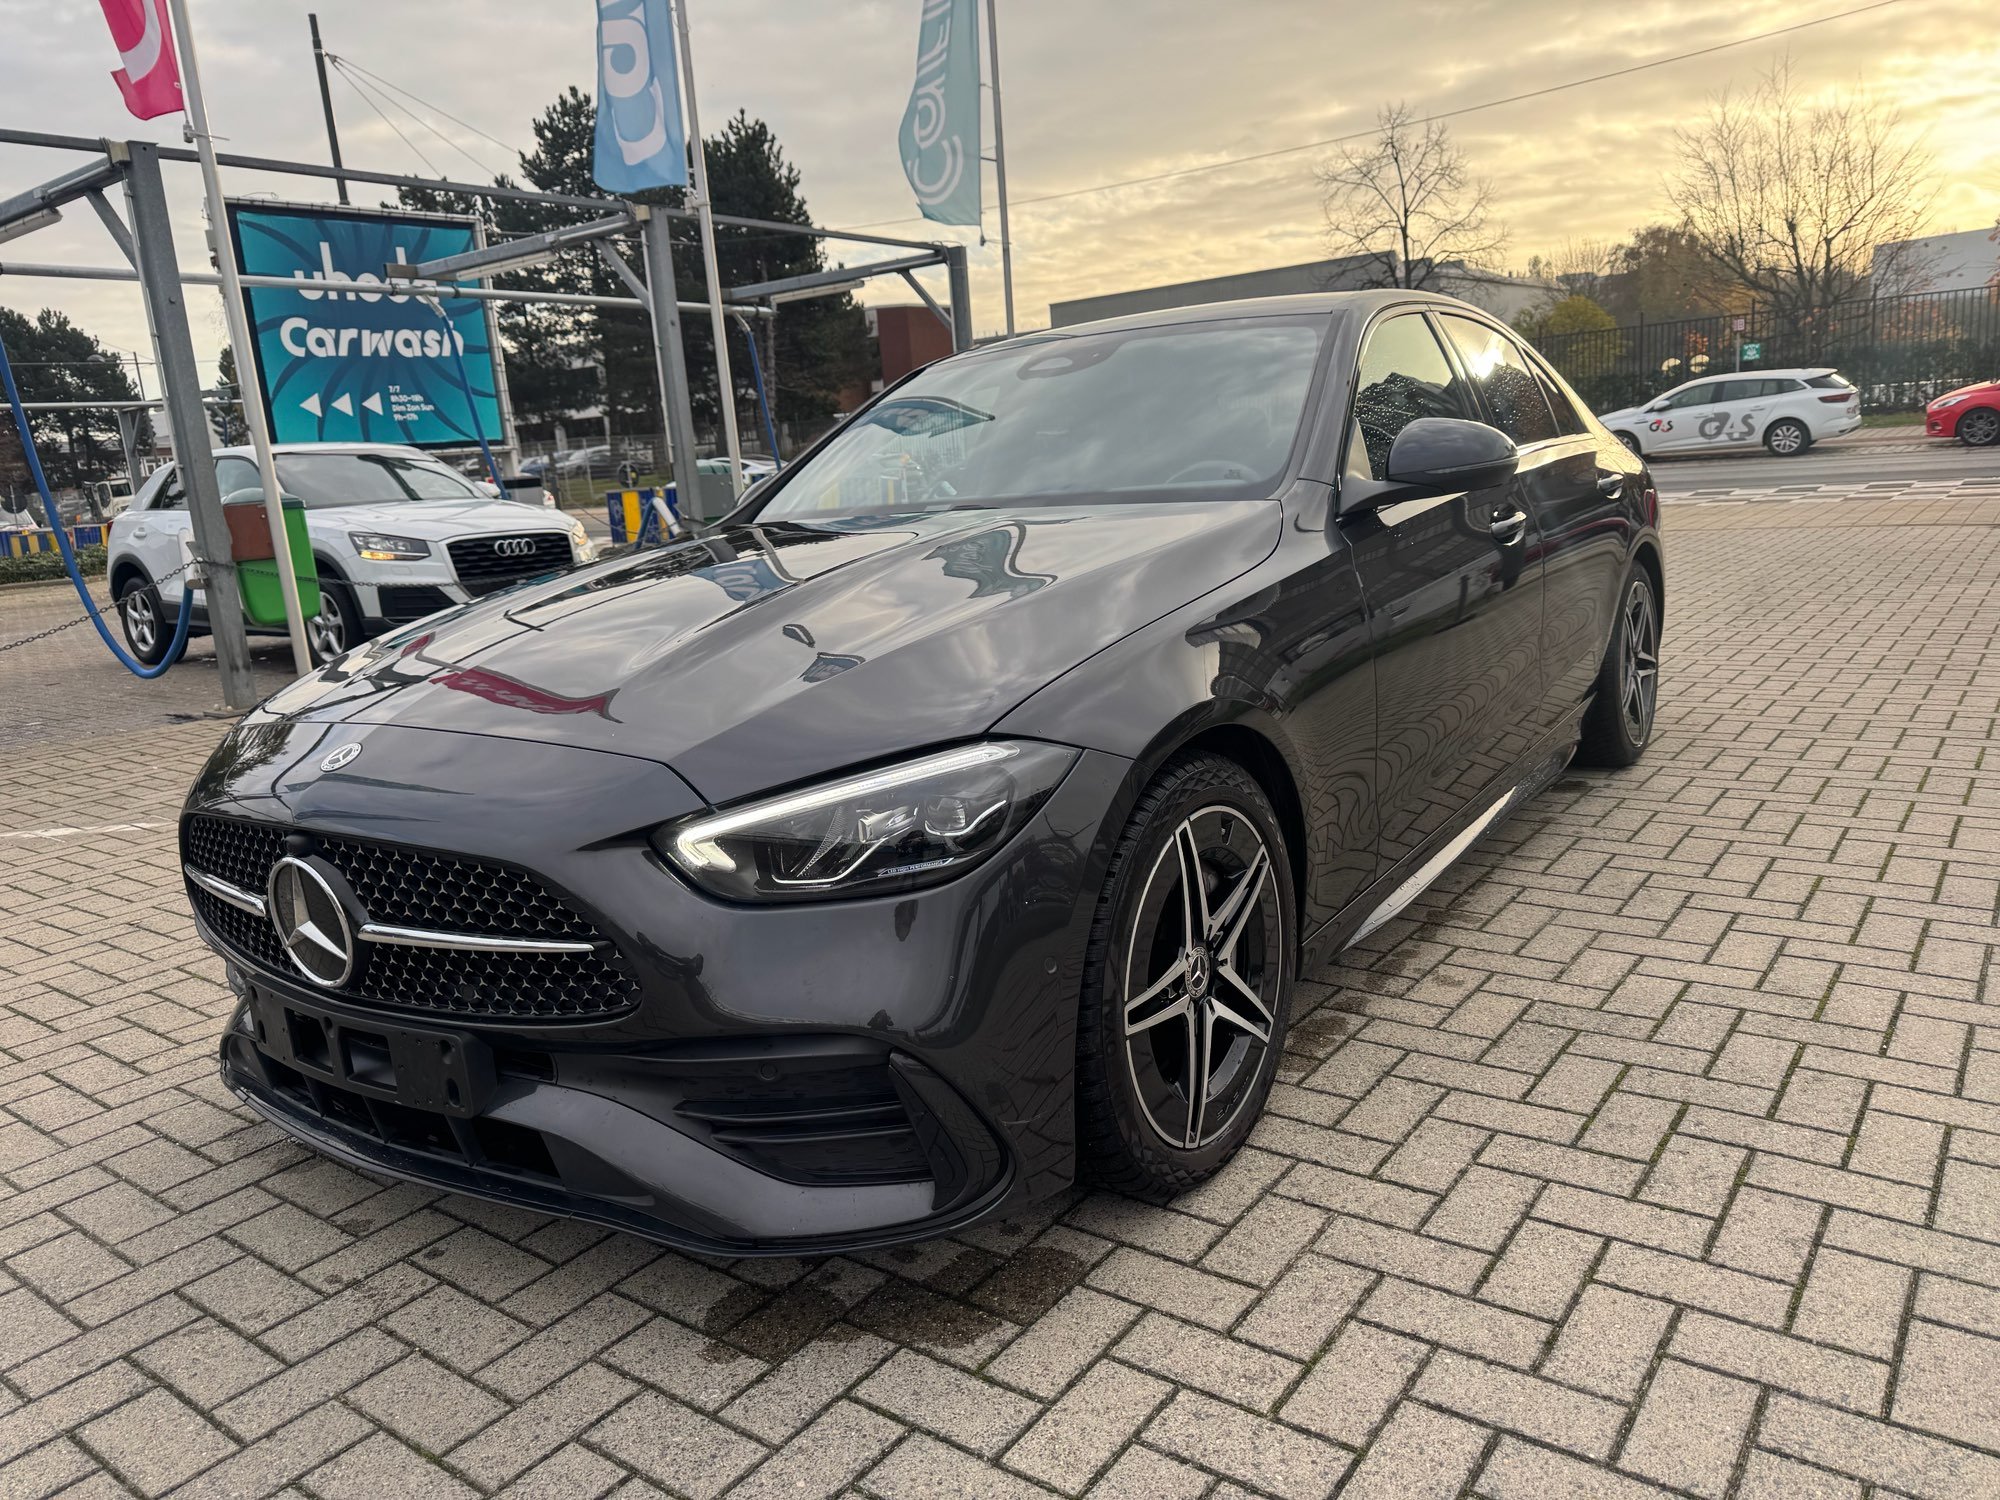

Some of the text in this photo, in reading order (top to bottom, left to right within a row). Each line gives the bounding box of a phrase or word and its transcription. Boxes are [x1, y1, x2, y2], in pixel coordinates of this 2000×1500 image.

[280, 317, 464, 358] Carwash
[1649, 418, 1673, 433] G4S
[1698, 411, 1756, 441] G4S
